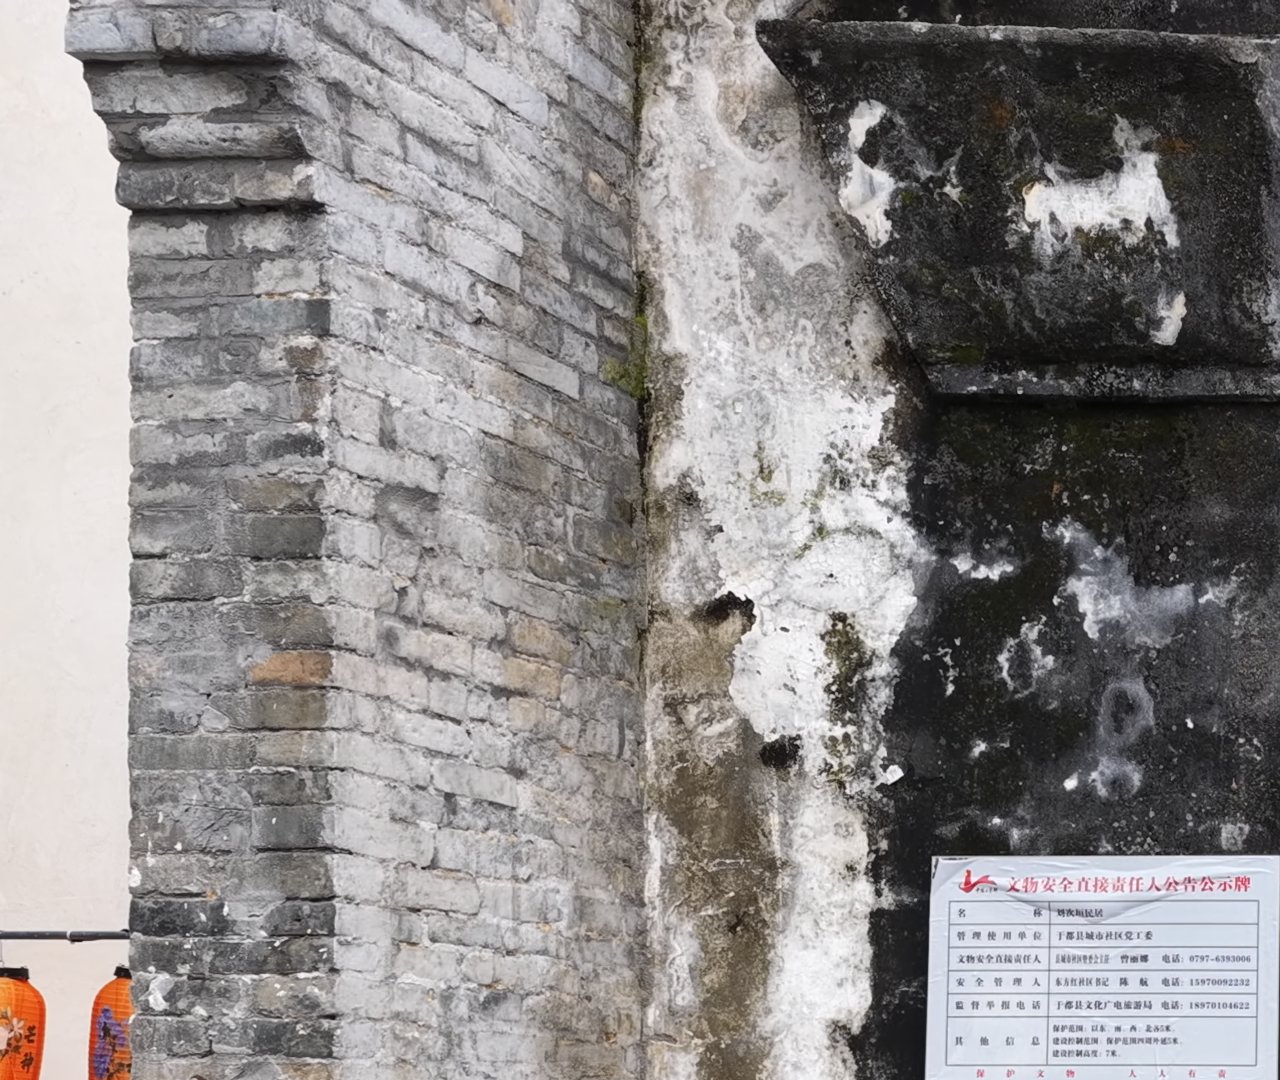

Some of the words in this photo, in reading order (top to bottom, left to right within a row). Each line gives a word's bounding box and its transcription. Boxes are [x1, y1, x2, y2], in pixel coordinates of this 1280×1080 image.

[1006, 876, 1251, 893] 文物安全直接责任人公告公示牌
[1056, 931, 1153, 941] 于都县城市社区党工委
[957, 954, 1042, 964] 文物安全直接责任人
